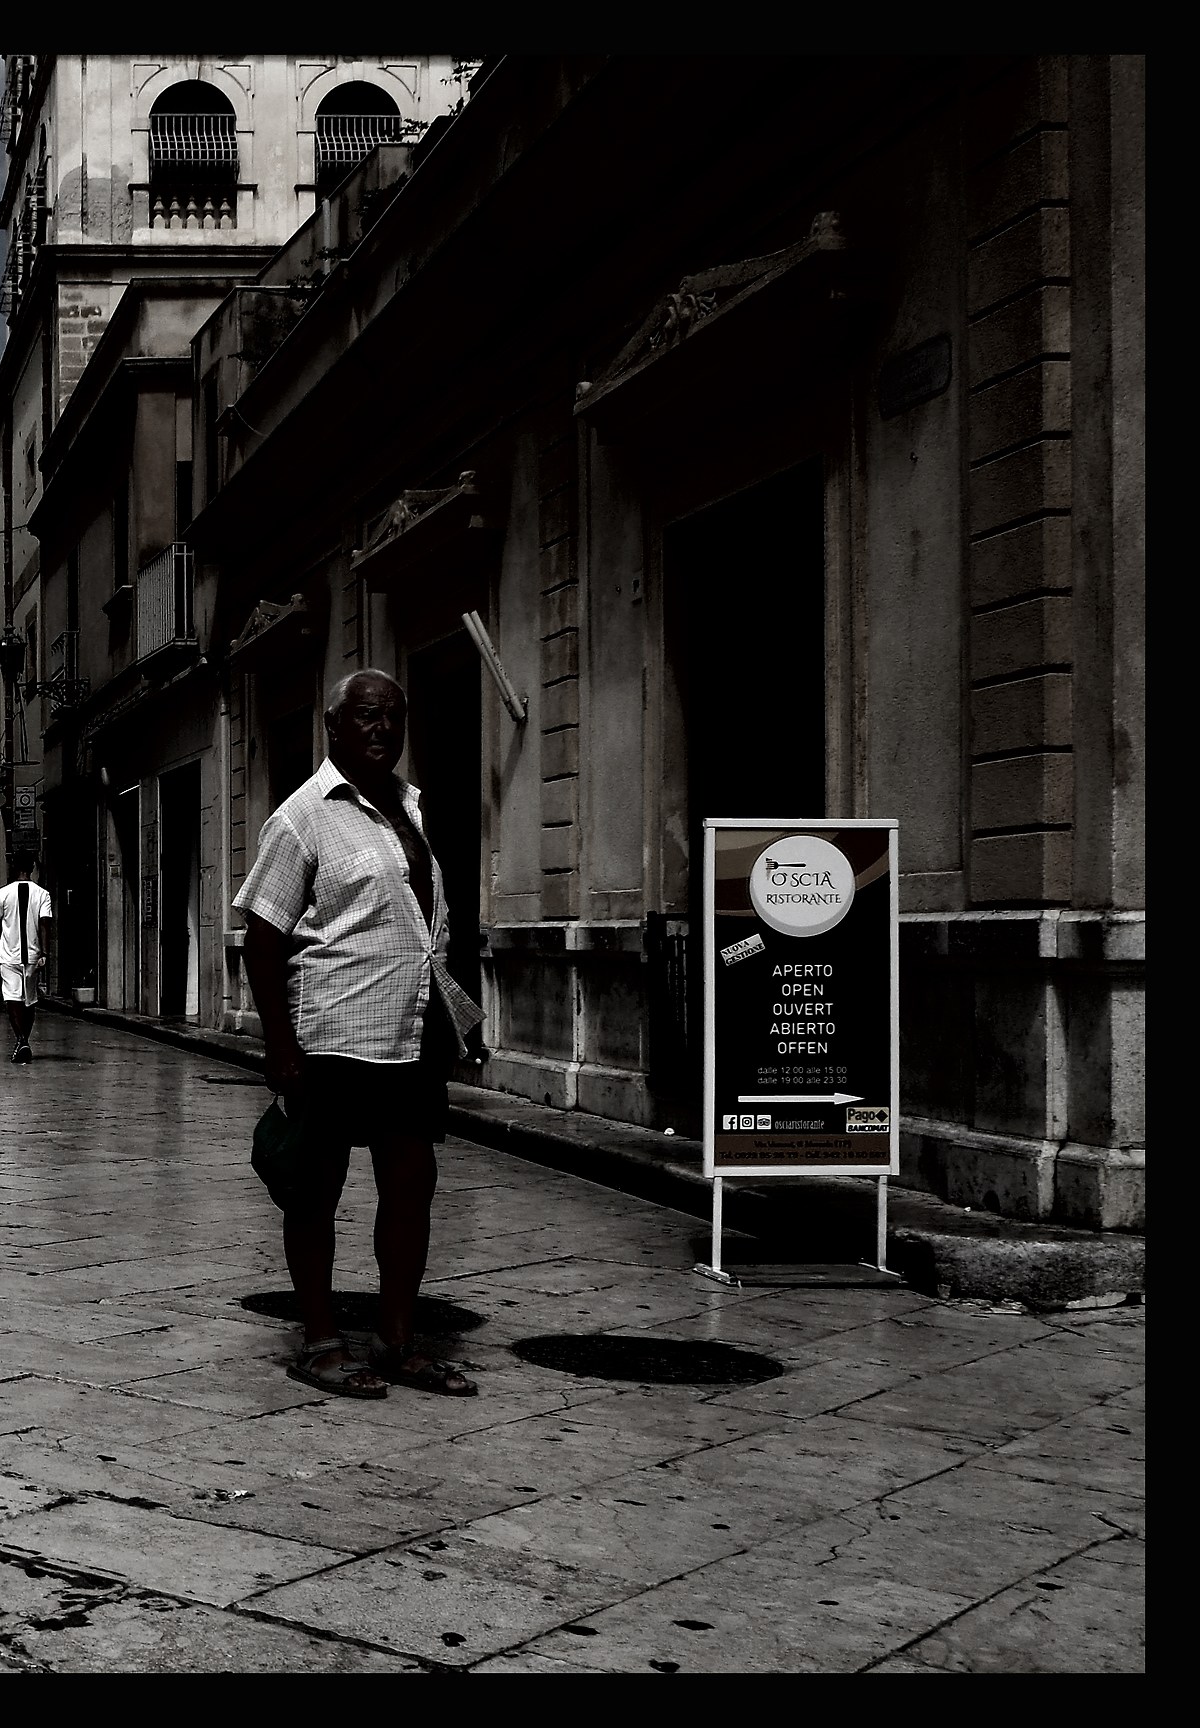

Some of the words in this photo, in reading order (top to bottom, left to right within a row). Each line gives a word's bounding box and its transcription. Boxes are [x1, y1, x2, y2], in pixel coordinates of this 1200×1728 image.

[766, 893, 842, 905] RISTORANTE
[721, 941, 750, 957] NUOVA
[726, 942, 764, 965] GESTIONE
[772, 964, 833, 977] APERTO
[781, 983, 824, 996] OPEN
[773, 1003, 834, 1016] OUVERT
[769, 1022, 836, 1035] ABIERTO
[777, 1041, 828, 1054] OFFEN
[757, 1066, 778, 1074] dalle
[806, 1066, 821, 1074] alle
[757, 1076, 778, 1084] dalle
[806, 1076, 821, 1084] alle
[847, 1108, 875, 1123] Pago
[847, 1124, 889, 1132] BANCOMAT
